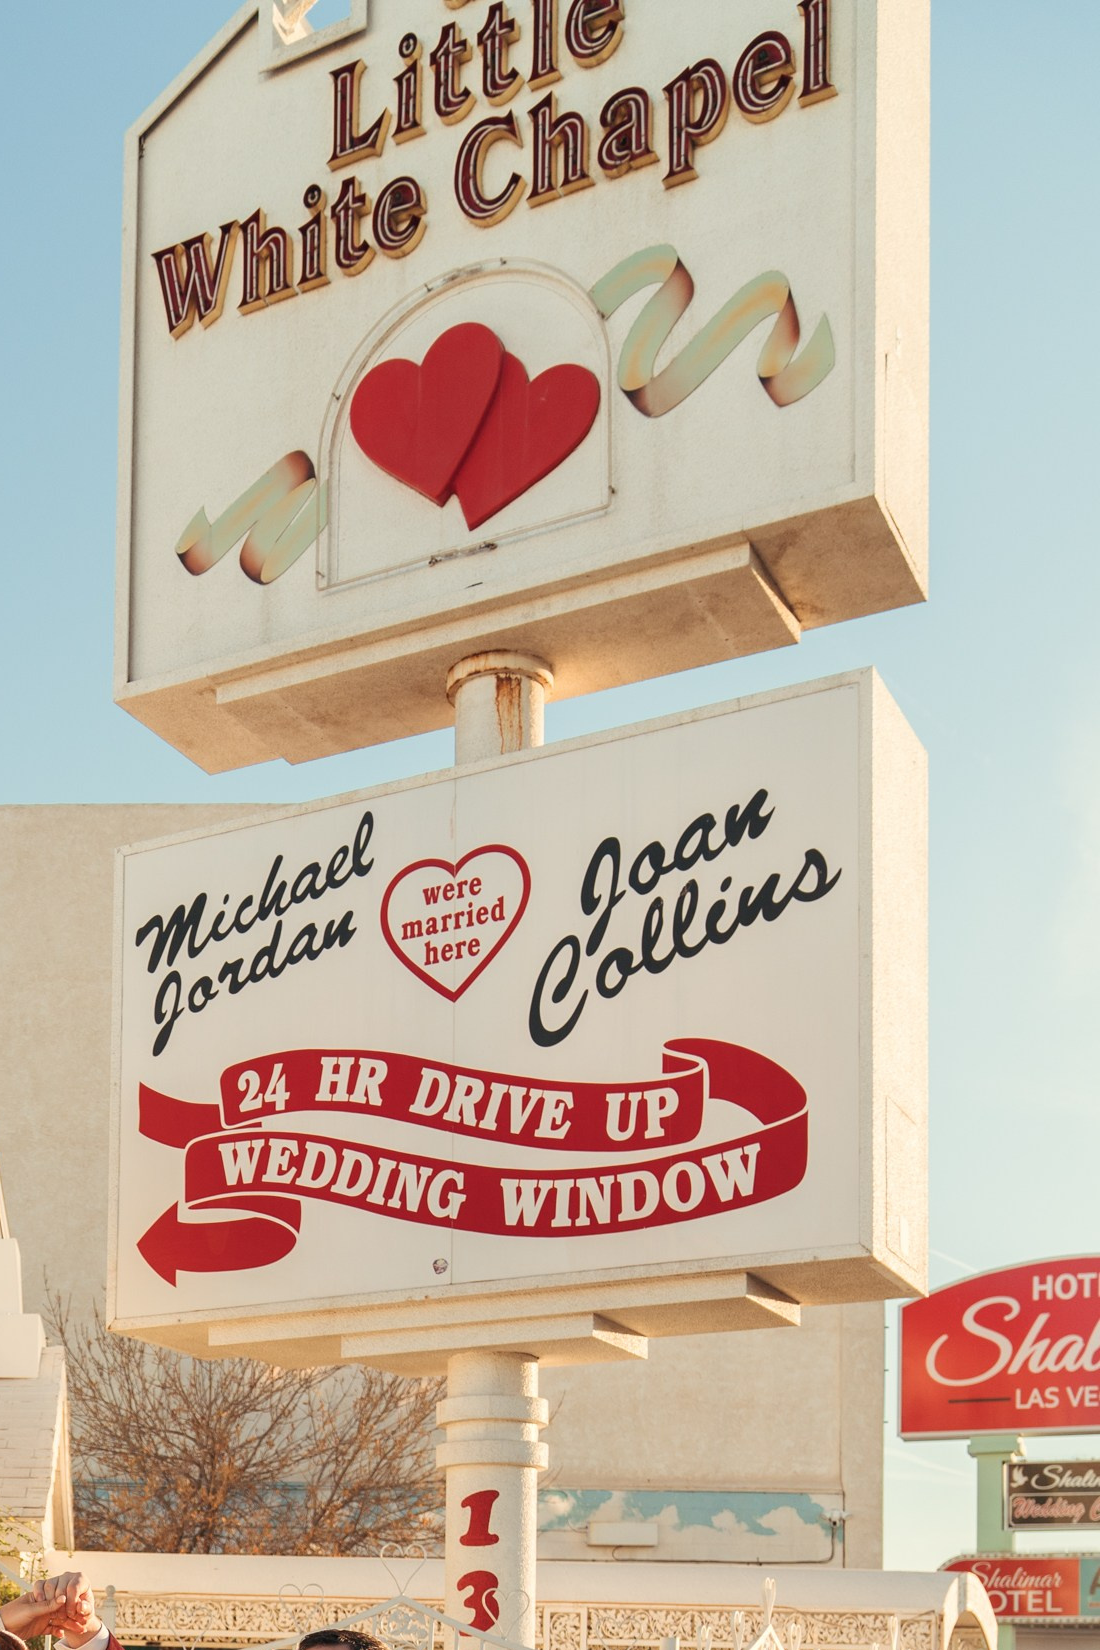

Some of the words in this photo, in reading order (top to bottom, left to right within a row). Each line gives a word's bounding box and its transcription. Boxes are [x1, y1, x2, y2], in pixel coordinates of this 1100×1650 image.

[328, 0, 625, 171] Little
[153, 174, 427, 340] White
[454, 0, 838, 228] Chapel
[136, 811, 374, 973] Michael
[423, 877, 482, 905] were
[581, 789, 775, 956] Joan
[401, 896, 505, 940] married
[529, 848, 842, 1047] Collins
[424, 938, 481, 965] here
[153, 911, 357, 1057] Jordan
[238, 1063, 290, 1113] 24
[315, 1056, 388, 1106] HR
[409, 1067, 574, 1140] DRIVE
[605, 1087, 679, 1141] UP
[219, 1139, 466, 1219] WEDDING
[500, 1143, 761, 1227] WINDOW
[1032, 1272, 1100, 1301] HOT
[1015, 1386, 1060, 1409] LAS
[1013, 1496, 1085, 1523] Wedding
[971, 1561, 1063, 1588] Shalimar
[986, 1590, 1063, 1613] OTEL
